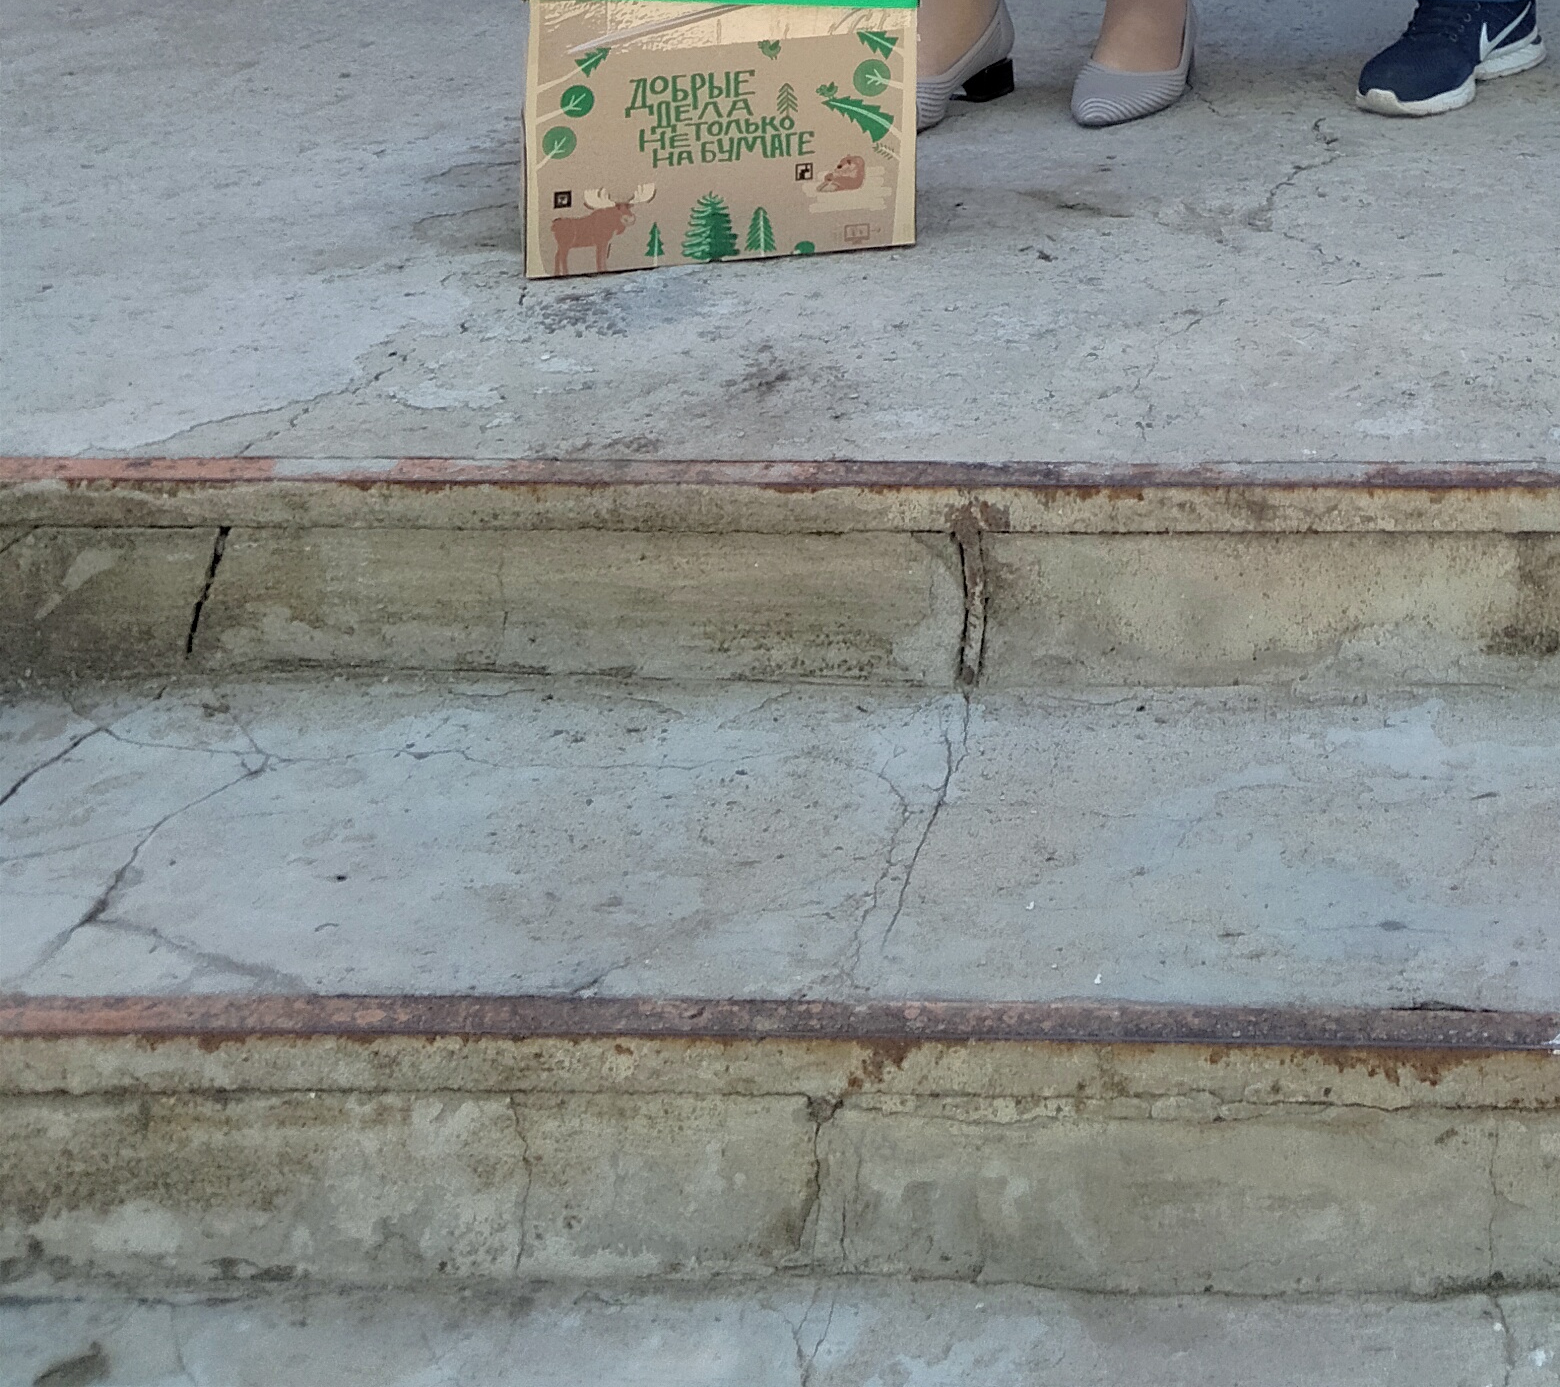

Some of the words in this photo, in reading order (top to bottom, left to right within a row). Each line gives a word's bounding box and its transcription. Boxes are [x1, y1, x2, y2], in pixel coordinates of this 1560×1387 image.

[625, 69, 756, 118] ДОБРЫЕ
[638, 128, 691, 153] НЕ
[684, 115, 795, 142] ТОЛЬКО
[651, 98, 754, 135] ДЕЛА
[652, 148, 694, 168] НА
[700, 130, 815, 164] БУМАГЕ
